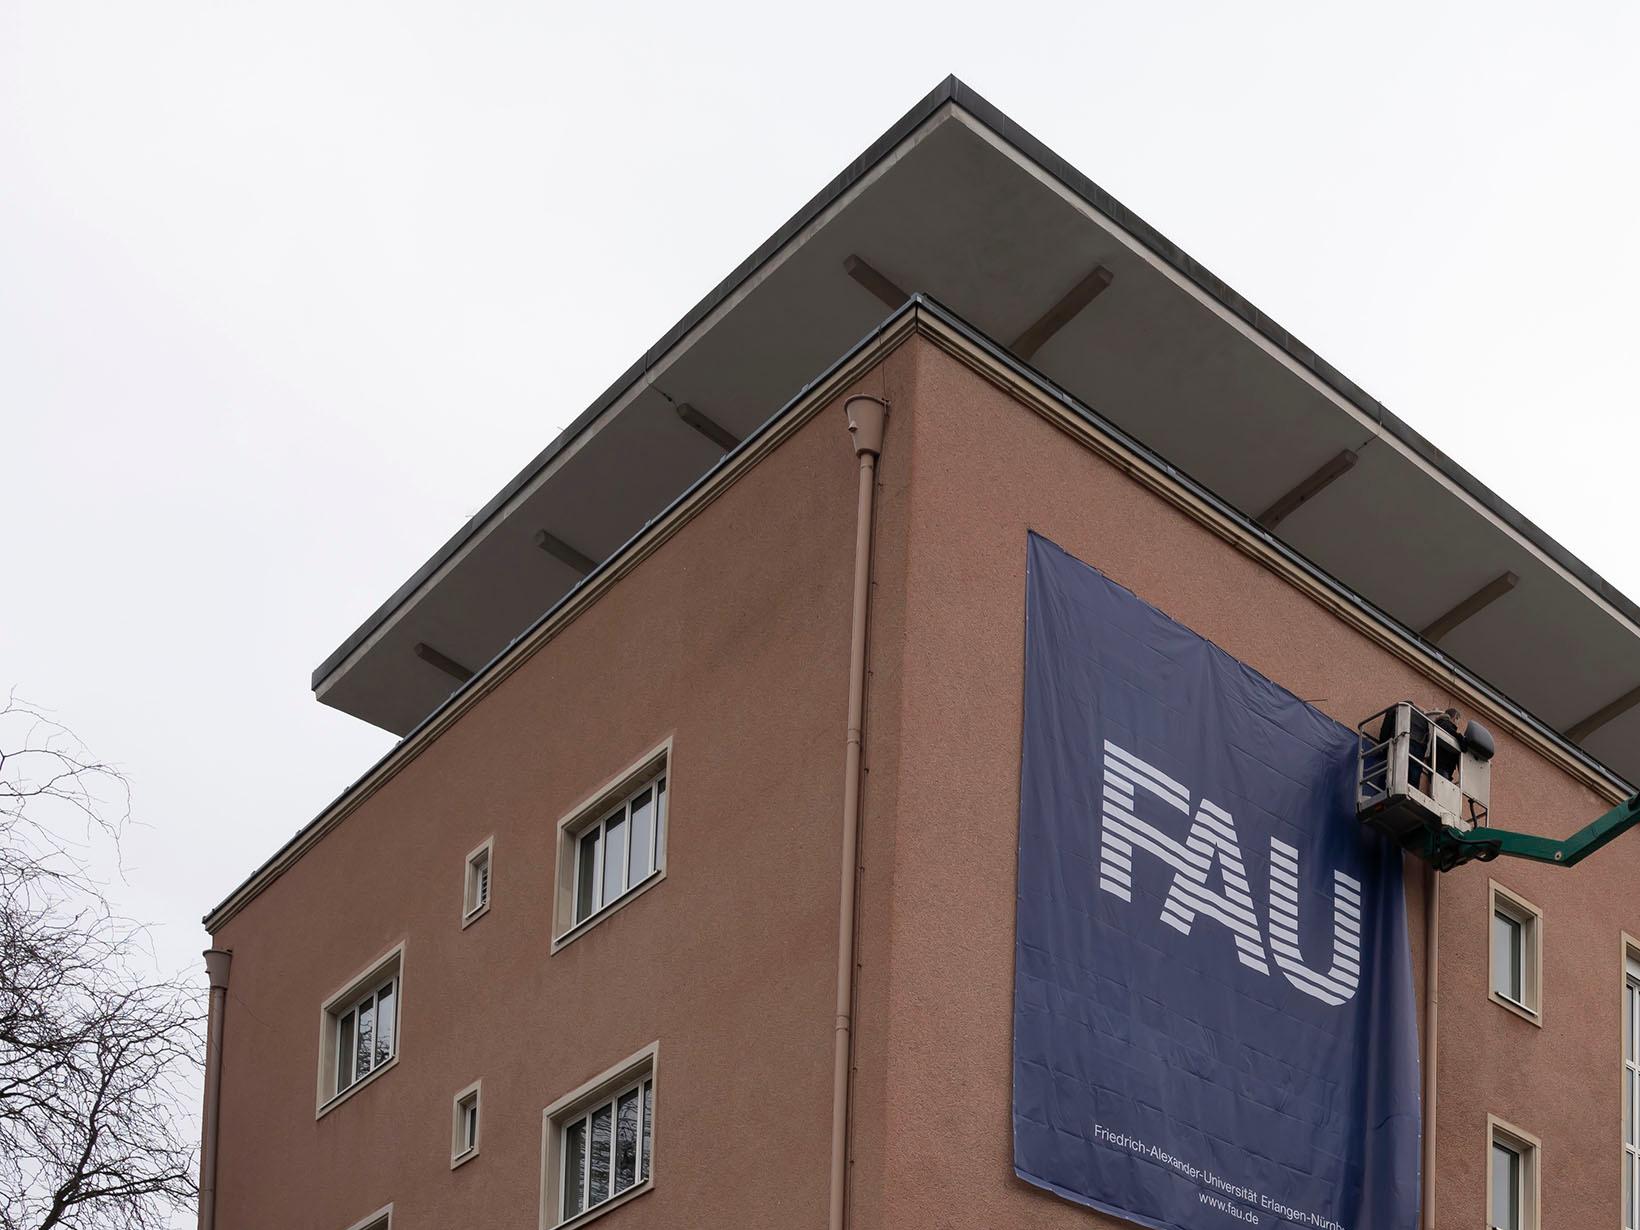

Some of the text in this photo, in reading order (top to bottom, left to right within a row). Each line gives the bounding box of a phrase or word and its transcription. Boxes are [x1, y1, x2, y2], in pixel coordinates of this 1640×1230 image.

[1100, 739, 1361, 1006] FAU
[1094, 1124, 1258, 1204] Friedrich-Alexander-Universität
[1198, 1192, 1259, 1225] www.fau.de
